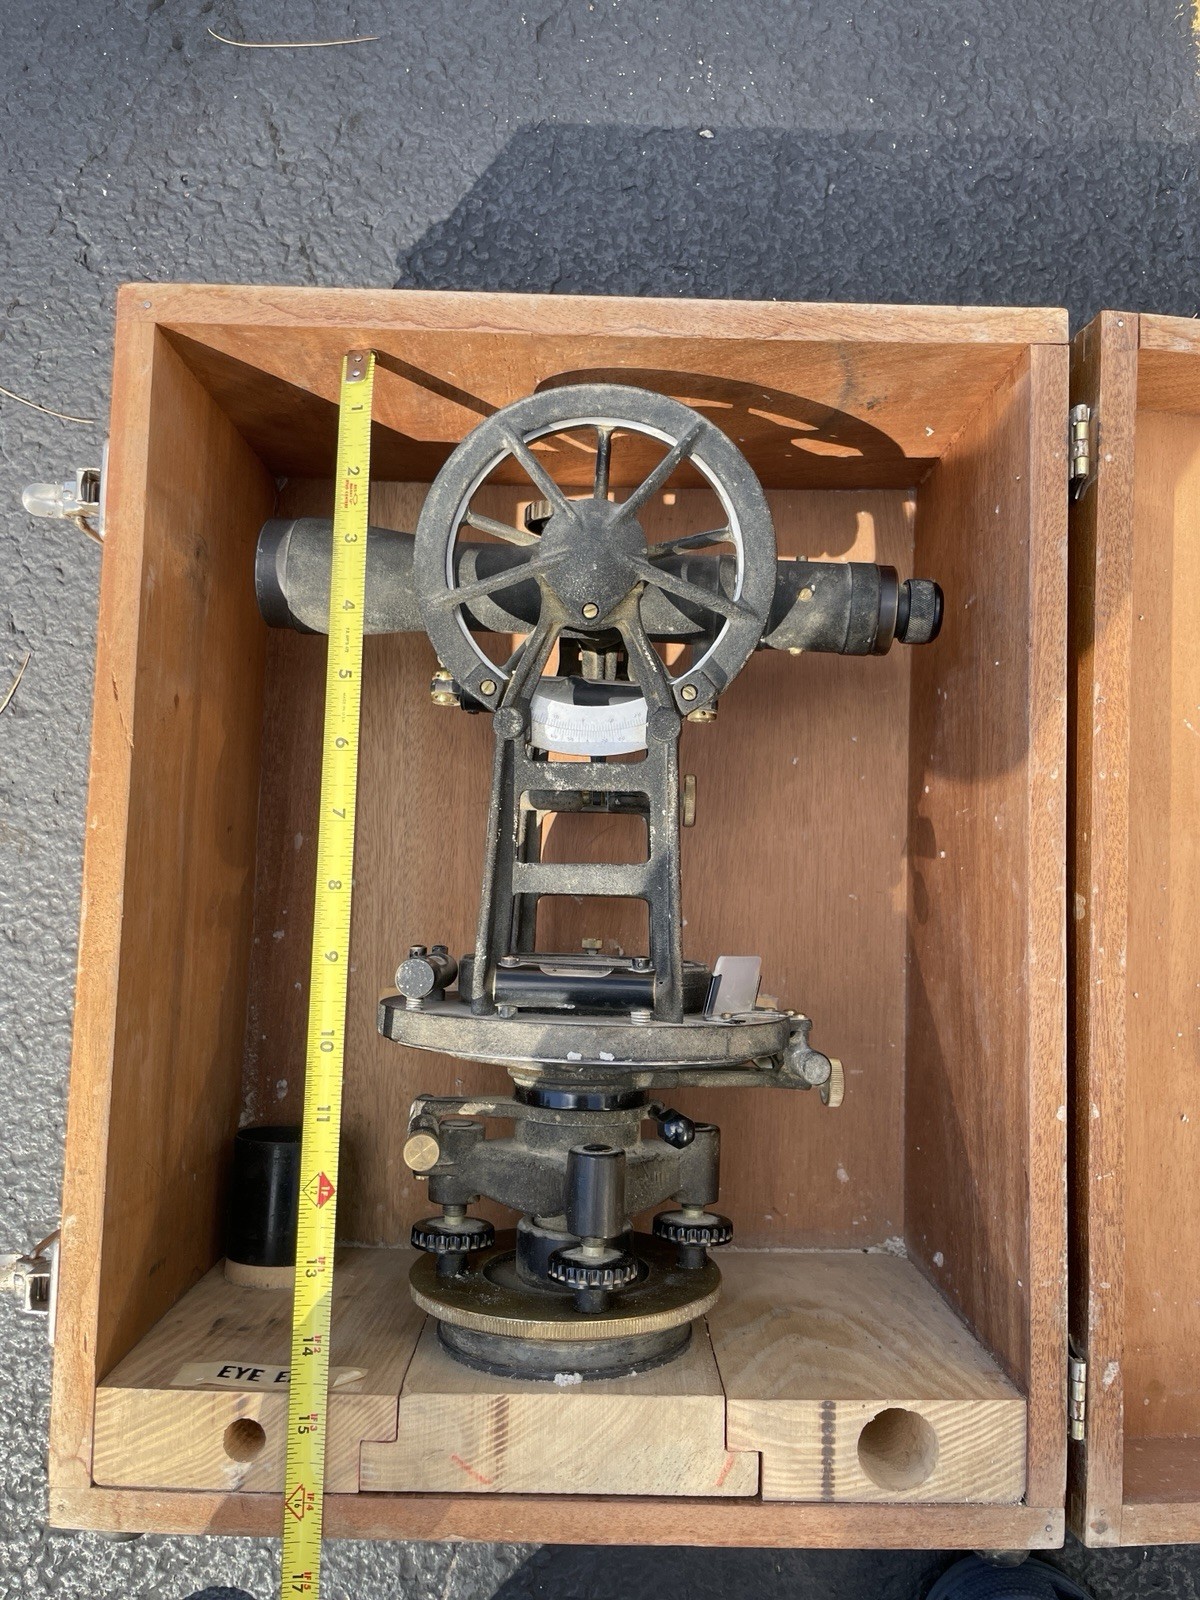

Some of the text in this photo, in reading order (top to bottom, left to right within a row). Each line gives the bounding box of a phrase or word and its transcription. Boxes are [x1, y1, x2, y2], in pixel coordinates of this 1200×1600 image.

[347, 466, 360, 476] 2
[344, 533, 358, 543] 3
[342, 599, 355, 610] 4
[338, 669, 352, 679] 5
[335, 737, 349, 748] 6
[332, 808, 346, 819] 7
[328, 879, 342, 890] 8
[325, 950, 339, 962] 9
[320, 1030, 335, 1053] 10
[316, 1105, 331, 1122] 11
[309, 1185, 318, 1195] 12
[305, 1258, 317, 1278] 13
[302, 1336, 314, 1356] 14
[217, 1365, 291, 1383] EYE E
[297, 1414, 310, 1434] 15
[293, 1498, 302, 1508] 16
[292, 1573, 304, 1593] 17
